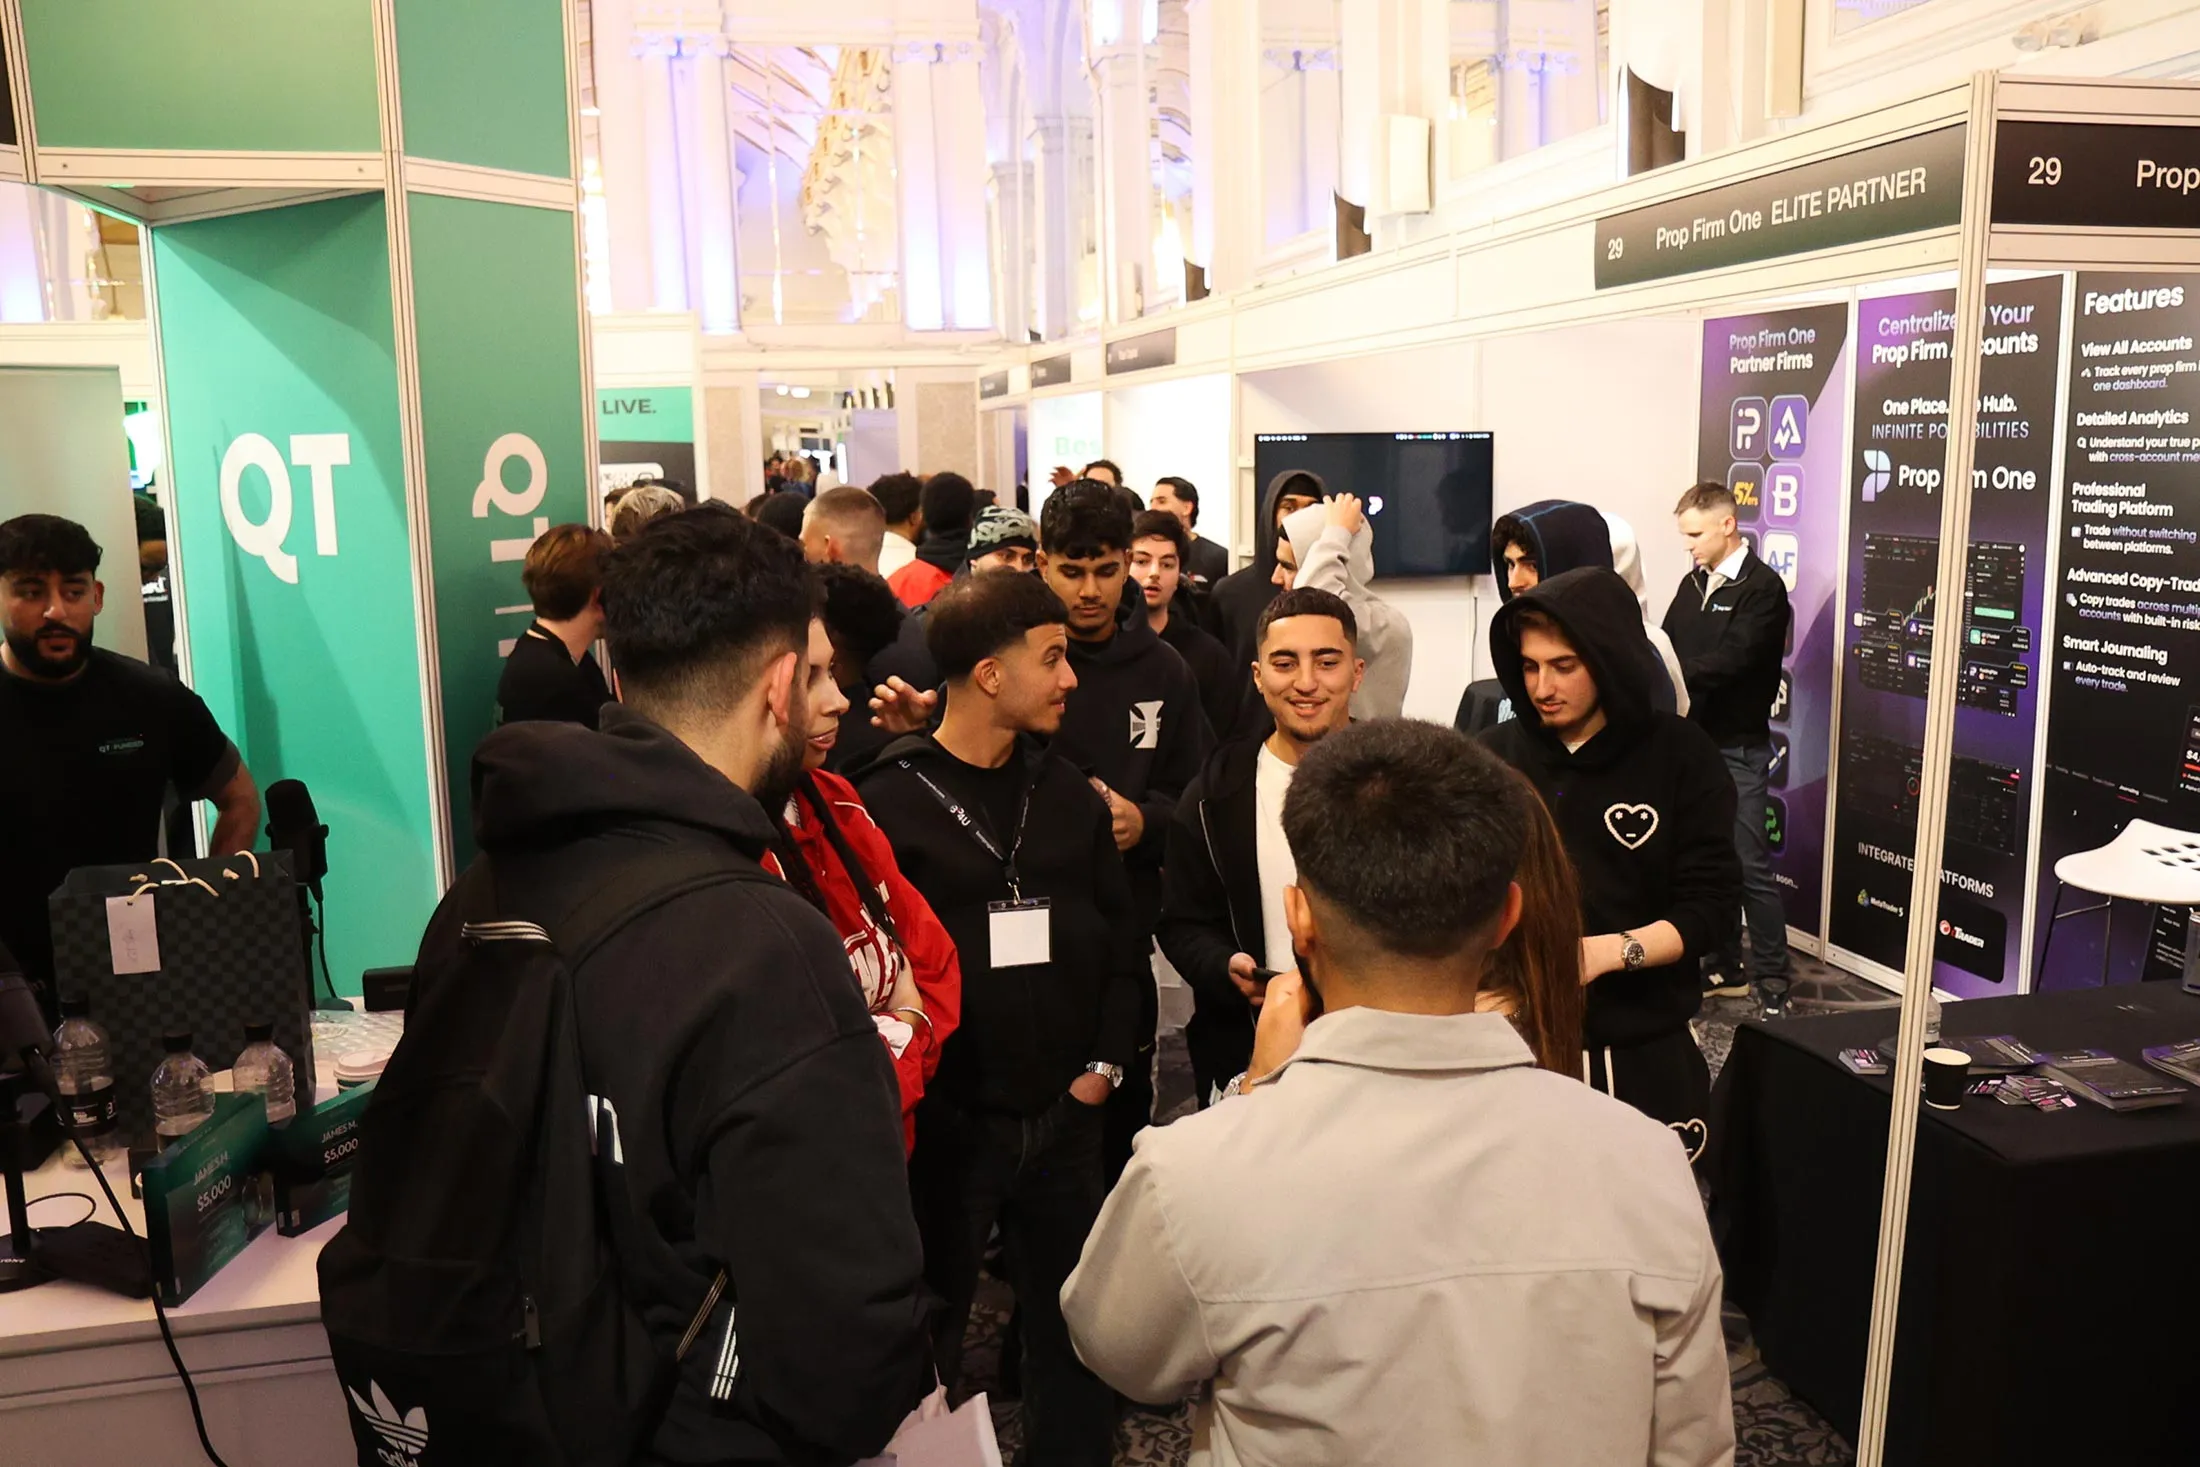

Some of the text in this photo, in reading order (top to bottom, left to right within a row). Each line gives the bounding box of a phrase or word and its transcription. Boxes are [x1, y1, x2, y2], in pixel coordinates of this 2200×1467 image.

[2027, 156, 2063, 186] 29
[2136, 159, 2200, 195] Prop
[1656, 166, 1927, 250] Prop Firm One ELITE PARTNER
[1607, 237, 1624, 261] 29
[2084, 287, 2184, 315] Features
[1989, 304, 2035, 326] Your
[1729, 327, 1816, 354] Prop Firm One
[2081, 335, 2194, 358] View All Accounts
[1729, 350, 1814, 374] Partner Firms
[1871, 344, 1908, 369] Prop
[1910, 338, 1948, 361] Firm
[2094, 360, 2197, 378] Track every prop firm
[2092, 377, 2169, 392] one dashboard.
[602, 398, 657, 415] LIVE.
[1882, 399, 1909, 416] One
[1910, 397, 1949, 415] Place.
[1982, 394, 2018, 413] Hub.
[2076, 408, 2190, 429] Detailed Analytics
[1871, 421, 2030, 439] INFINITE POBILITIES
[2089, 435, 2145, 449] Understand
[2145, 437, 2169, 450] your
[2169, 435, 2191, 448] true
[2088, 451, 2109, 462] with
[2109, 451, 2181, 463] cross-account
[1898, 464, 1941, 494] Prop
[1992, 465, 2037, 490] One
[2072, 481, 2146, 498] Professional
[219, 432, 351, 584] QT
[2071, 499, 2174, 519] Trading Platform
[2084, 523, 2197, 543] Trade without switching
[2083, 538, 2174, 554] between platforms.
[2067, 567, 2129, 586] Advanced
[2079, 592, 2105, 608] Copy
[2105, 595, 2136, 609] trades
[2136, 599, 2170, 612] across
[2079, 607, 2122, 621] accounts
[2122, 611, 2144, 625] with
[2144, 613, 2181, 628] built-in
[2063, 634, 2168, 666] Smart Journaling
[2074, 675, 2129, 692] every trade.
[2075, 660, 2181, 687] Auto-track and review
[1858, 842, 1994, 898] INTEGRATE ATFORMS
[321, 1127, 350, 1144] JAMES
[323, 1137, 359, 1164] $5,000
[196, 1174, 232, 1213] $5,000
